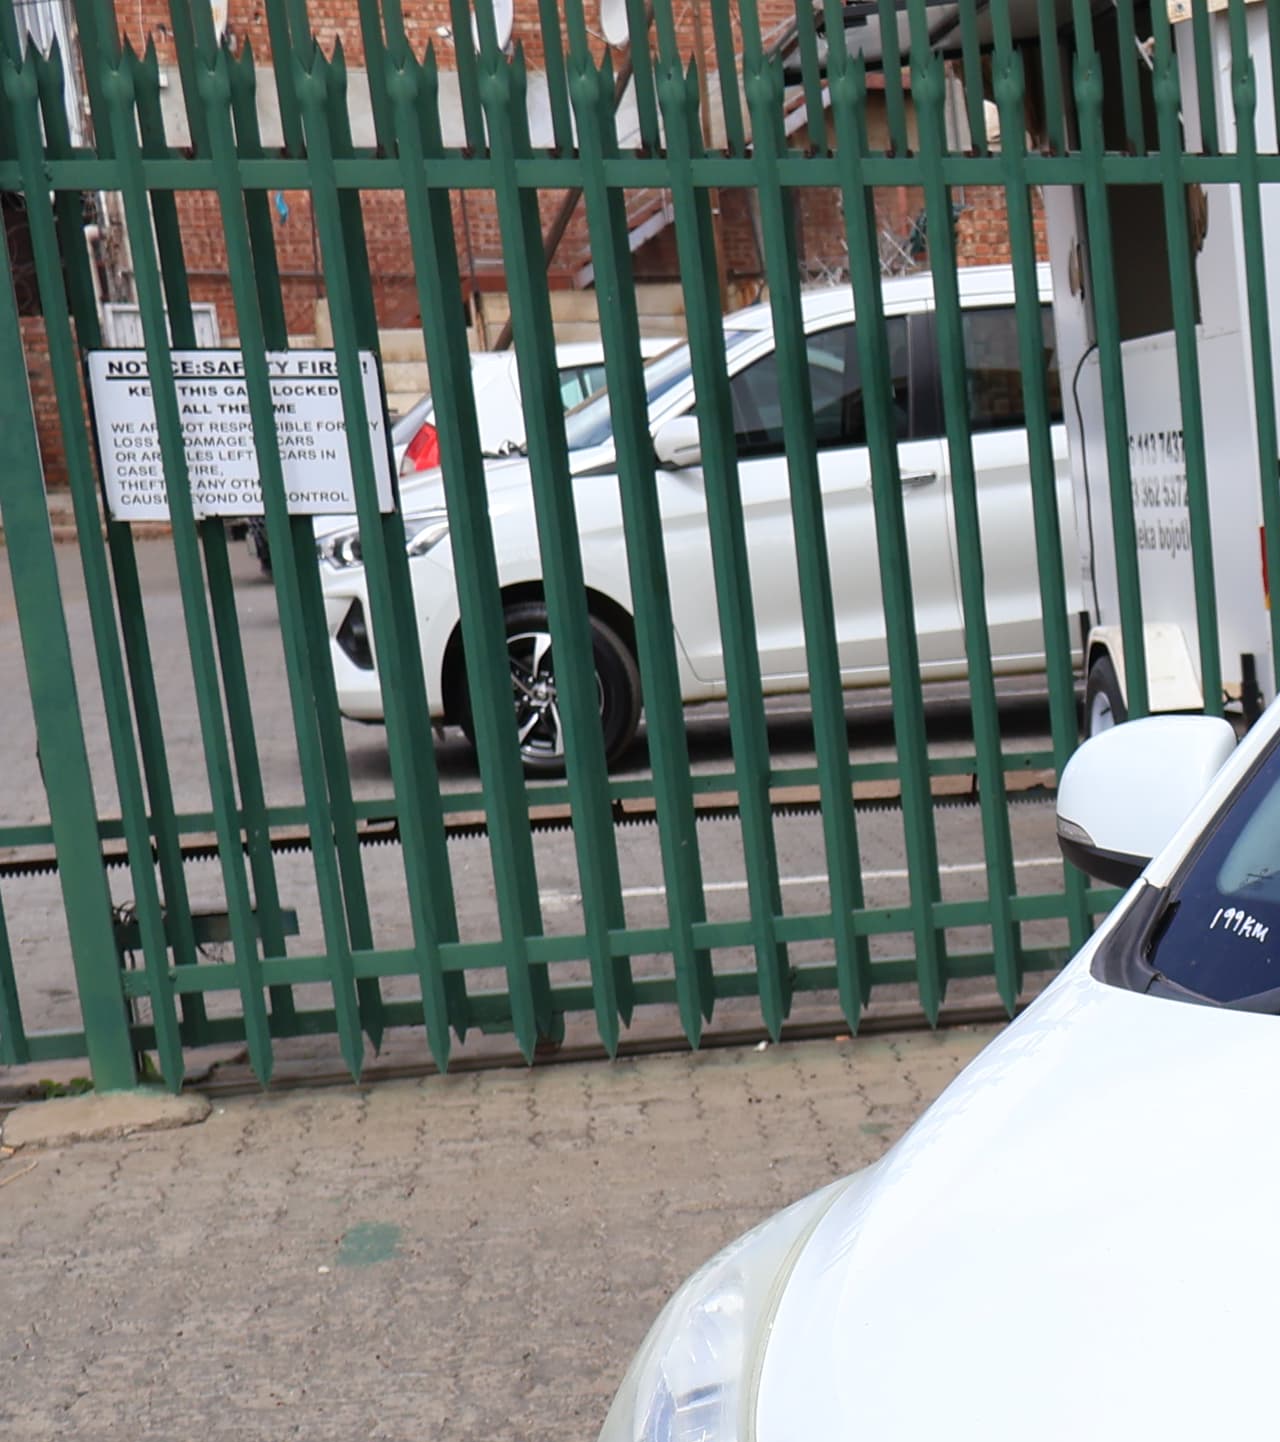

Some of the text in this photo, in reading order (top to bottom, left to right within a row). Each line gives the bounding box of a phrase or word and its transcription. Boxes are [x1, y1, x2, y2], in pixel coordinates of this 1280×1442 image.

[178, 385, 218, 397] THIS
[272, 385, 339, 397] LOCKED
[182, 403, 213, 415] ALL
[110, 422, 135, 434] WE
[113, 436, 154, 449] LOSS
[115, 451, 137, 462] OR
[218, 450, 255, 461] LEFT
[321, 449, 336, 460] IN
[116, 465, 158, 477] CASE
[196, 479, 227, 490] ANY
[287, 491, 350, 504] ONTROL
